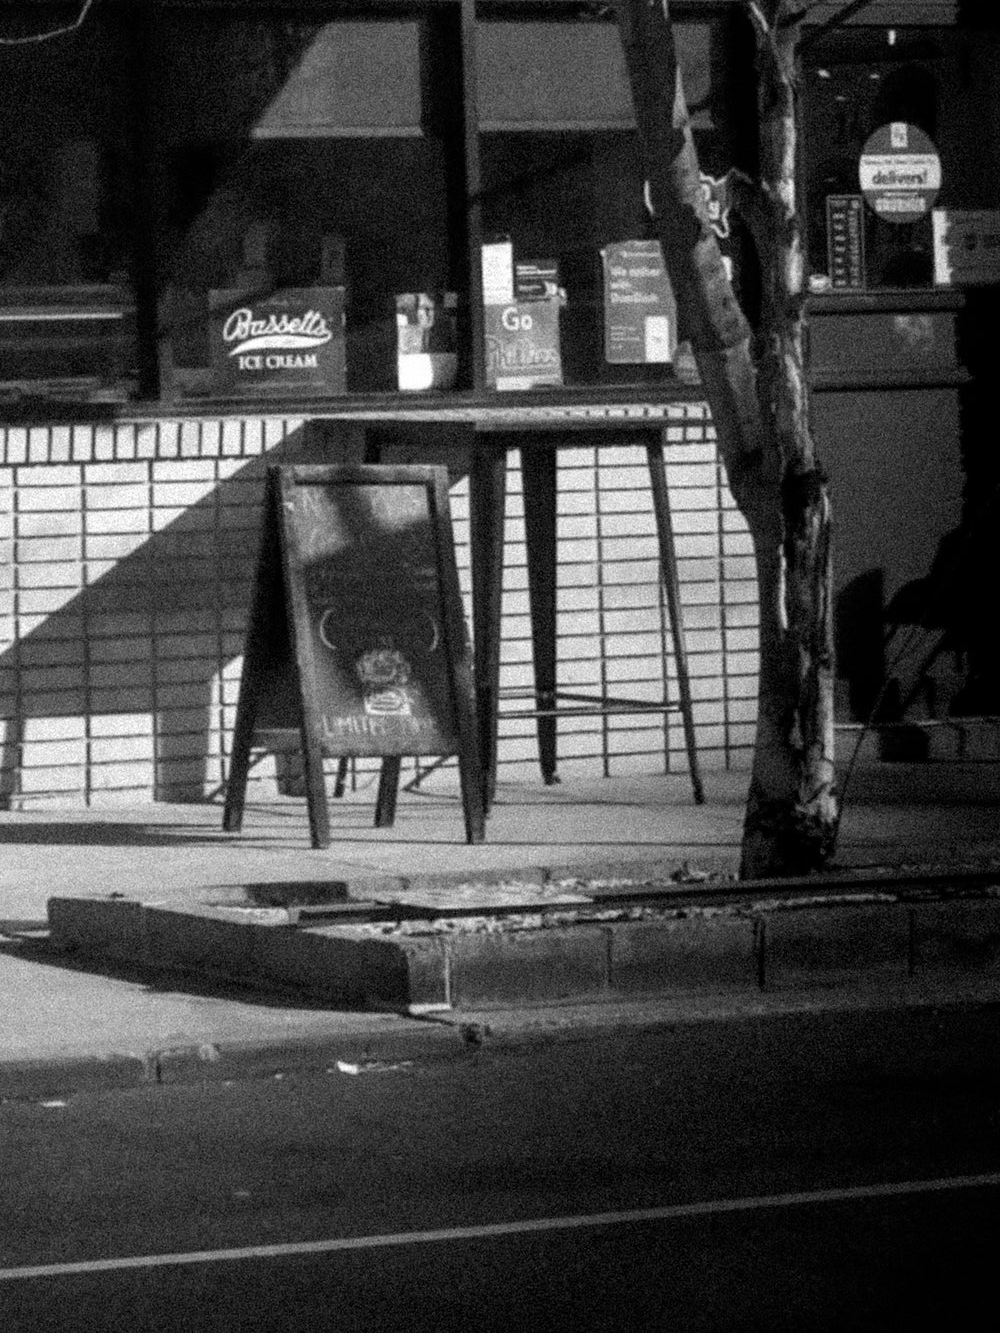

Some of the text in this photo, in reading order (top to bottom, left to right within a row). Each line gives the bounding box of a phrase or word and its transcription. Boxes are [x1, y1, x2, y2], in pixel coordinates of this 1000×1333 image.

[501, 305, 534, 332] Go
[239, 353, 319, 370] ICE CREAM
